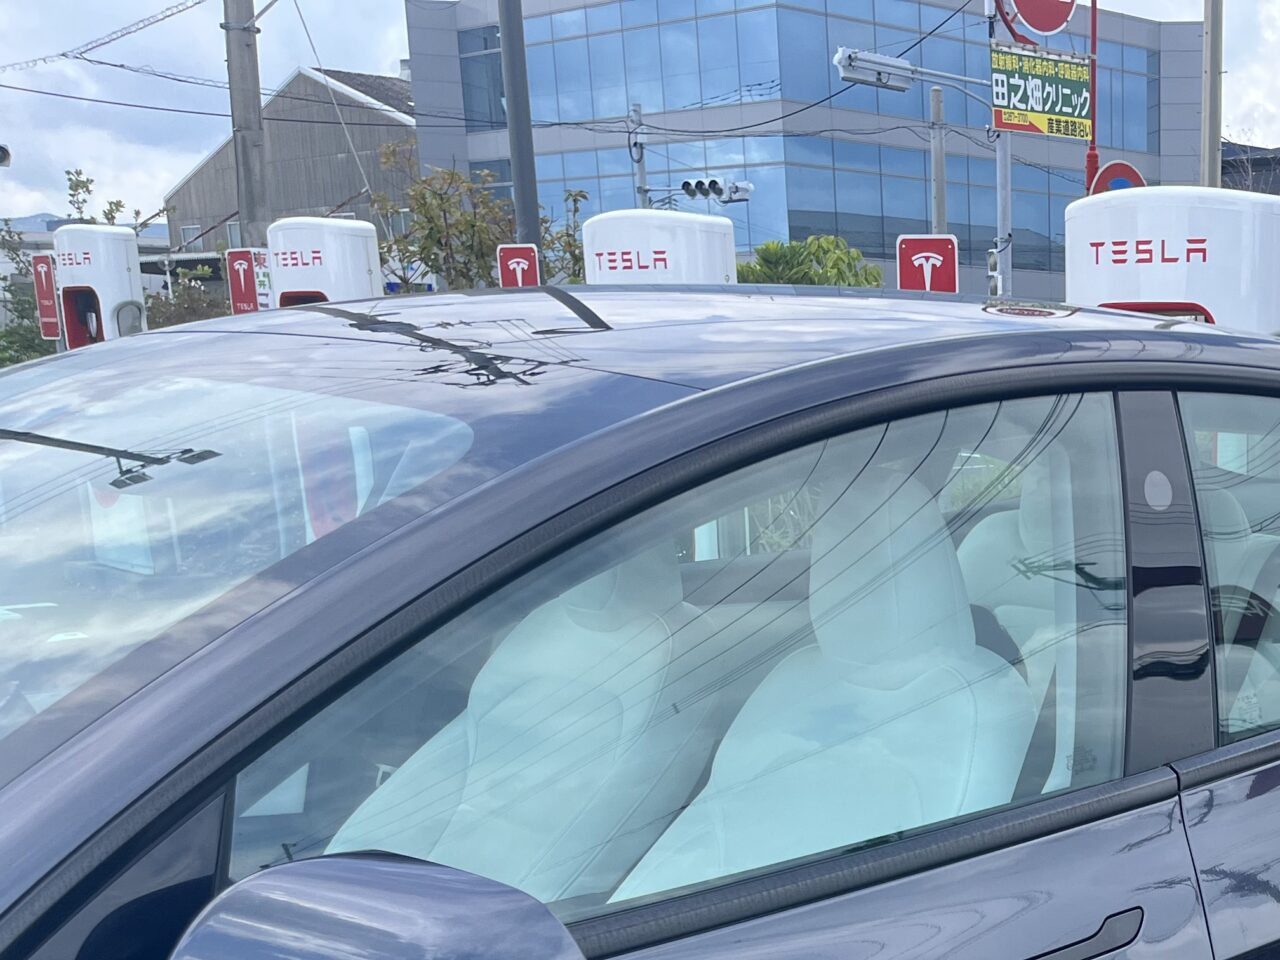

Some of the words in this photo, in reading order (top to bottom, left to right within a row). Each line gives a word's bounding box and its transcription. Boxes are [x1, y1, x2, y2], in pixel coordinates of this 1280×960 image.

[992, 72, 1090, 117] 田之畑クリニック
[274, 250, 323, 267] TESLA
[595, 250, 668, 271] TESLA
[1089, 238, 1207, 265] TESLA
